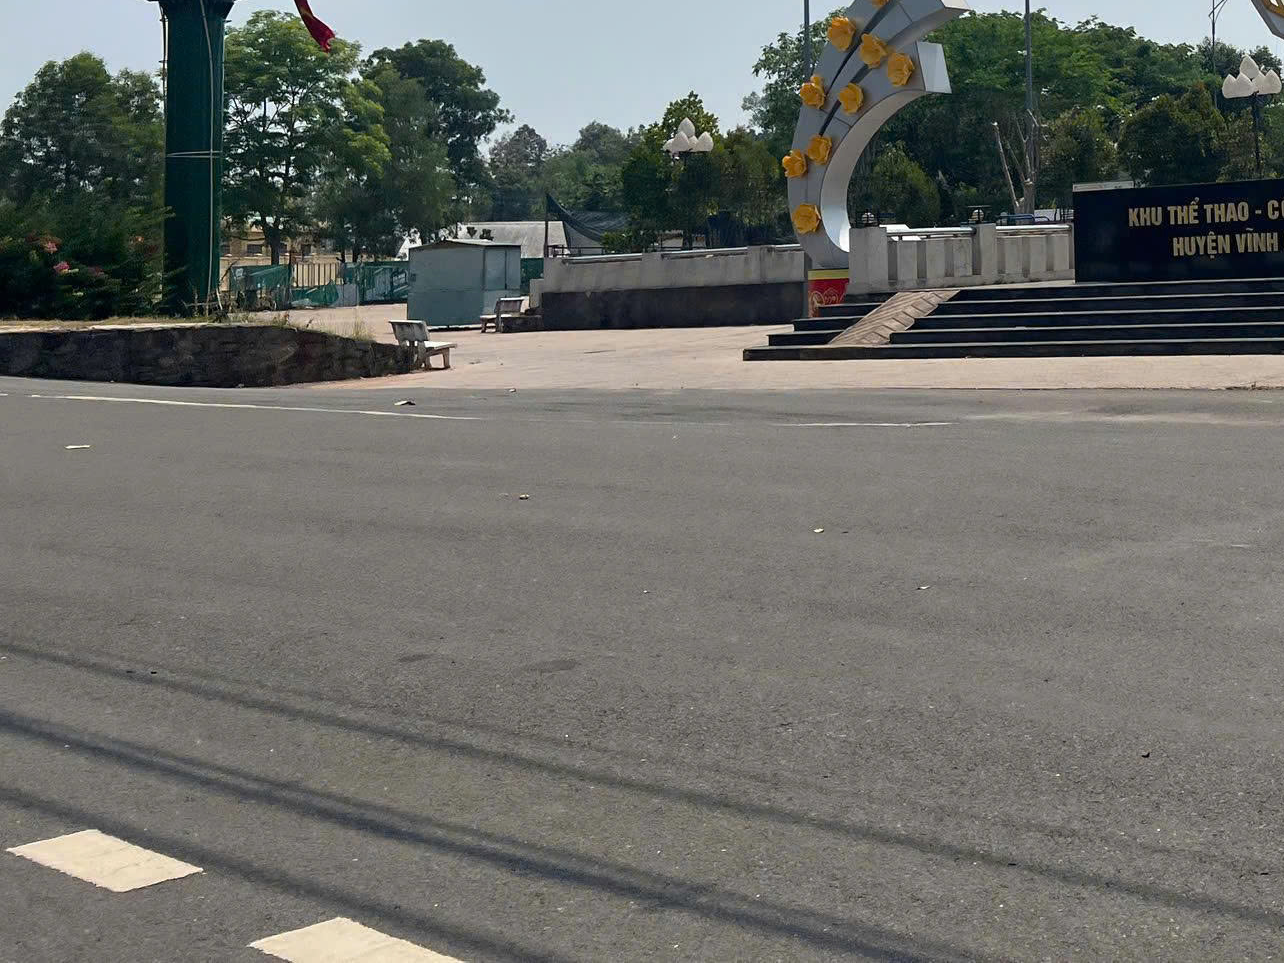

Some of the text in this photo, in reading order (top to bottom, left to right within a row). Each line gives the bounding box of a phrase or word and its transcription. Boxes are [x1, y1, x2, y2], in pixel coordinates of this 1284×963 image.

[1128, 206, 1163, 227] KHU
[1166, 197, 1200, 225] THỂ
[1203, 201, 1250, 223] THAO
[1172, 230, 1231, 260] HUYỆN
[1235, 227, 1279, 253] VĨNH
